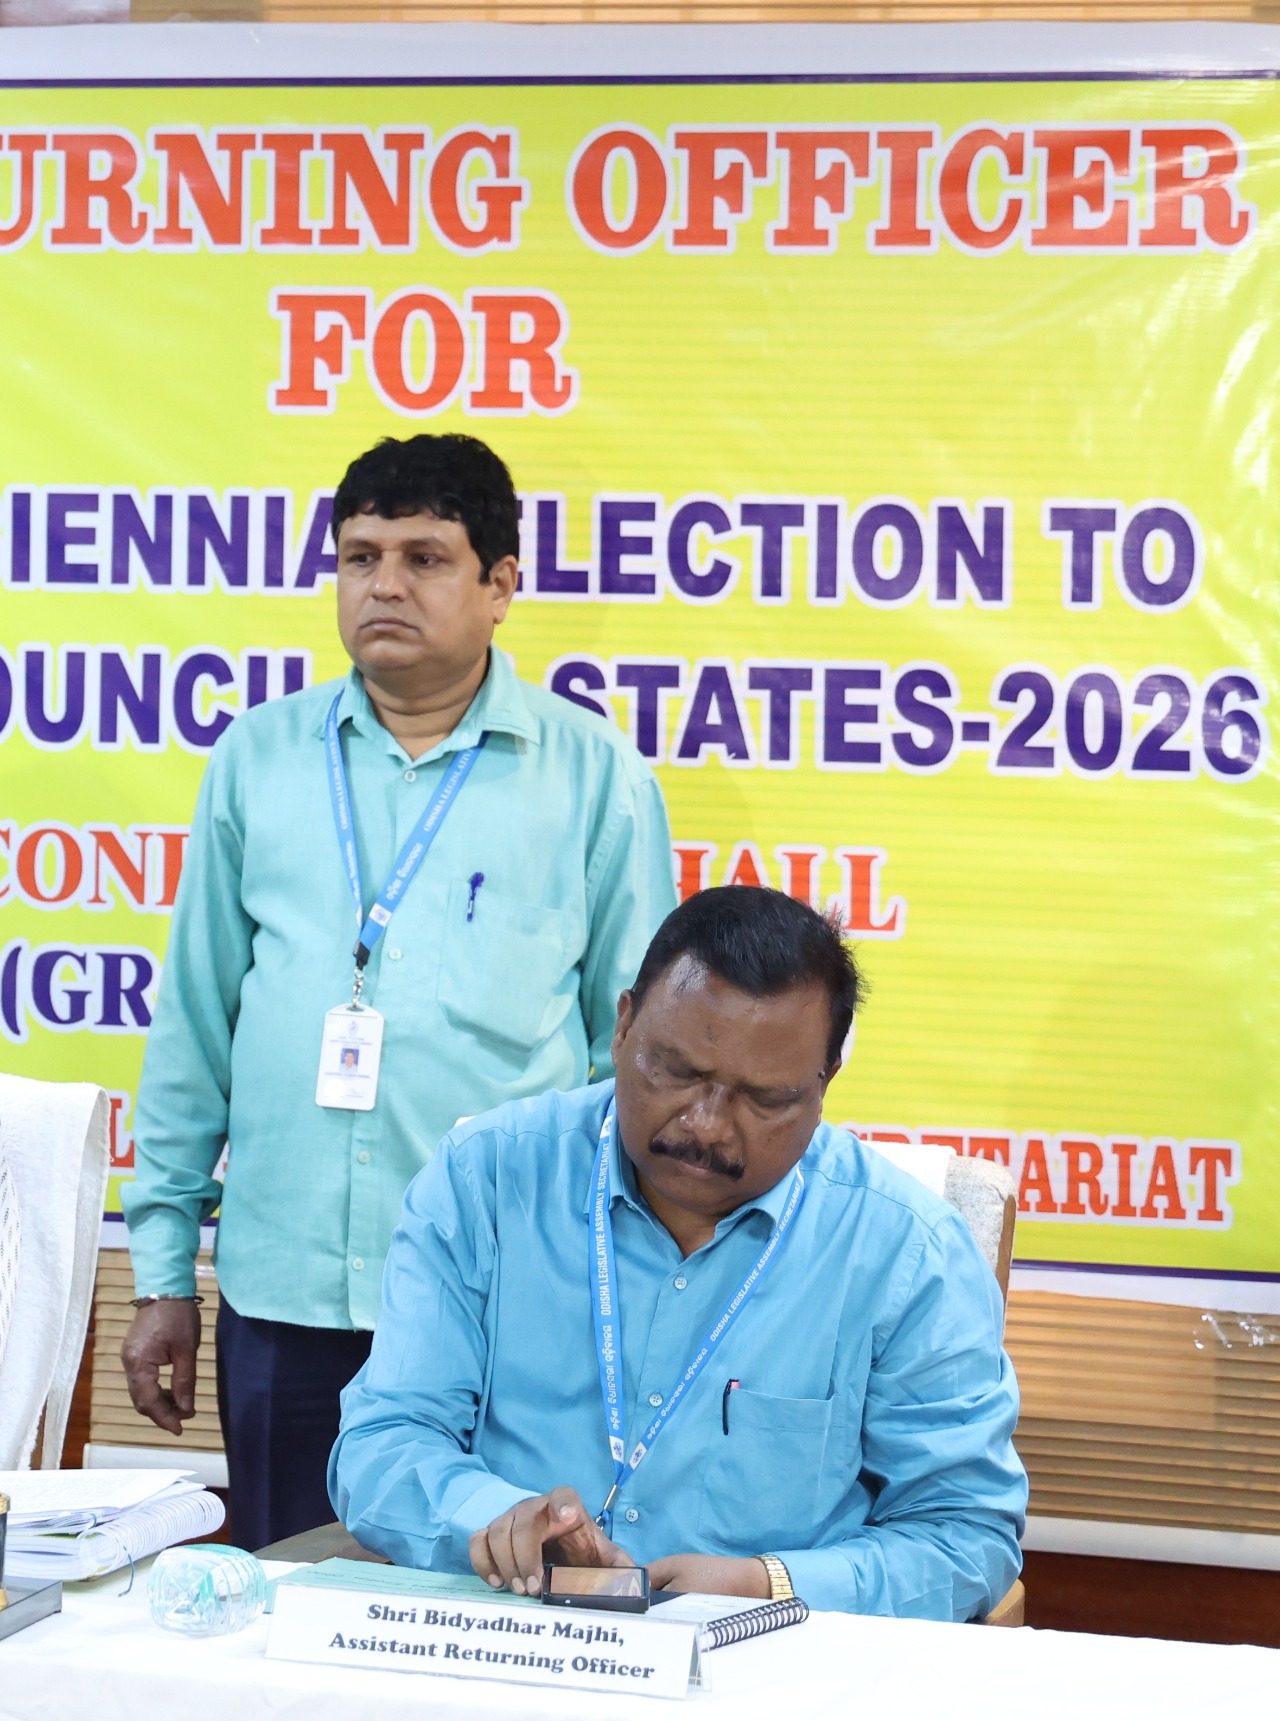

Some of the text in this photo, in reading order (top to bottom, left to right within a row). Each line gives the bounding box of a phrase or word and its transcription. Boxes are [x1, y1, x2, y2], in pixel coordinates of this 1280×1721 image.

[575, 130, 1247, 246] OFFICER
[278, 294, 570, 408] FOR
[518, 501, 1003, 599] LECTION
[1052, 508, 1194, 604] TO
[552, 662, 1259, 774] STATES-2026
[442, 749, 472, 801] LEGISLATIV
[2, 947, 152, 1034] (GR
[596, 1142, 611, 1316] ODISHA LEGISLATIVE ASSEMBLY SECRETARIAT
[709, 1181, 802, 1342] ODISHA LEGISLATIVE ASSEMBLY SECRETARIAT
[329, 1632, 655, 1678] Assistant Returning Officer
[367, 1604, 624, 1646] Shri Bidyadhar Majhi,
